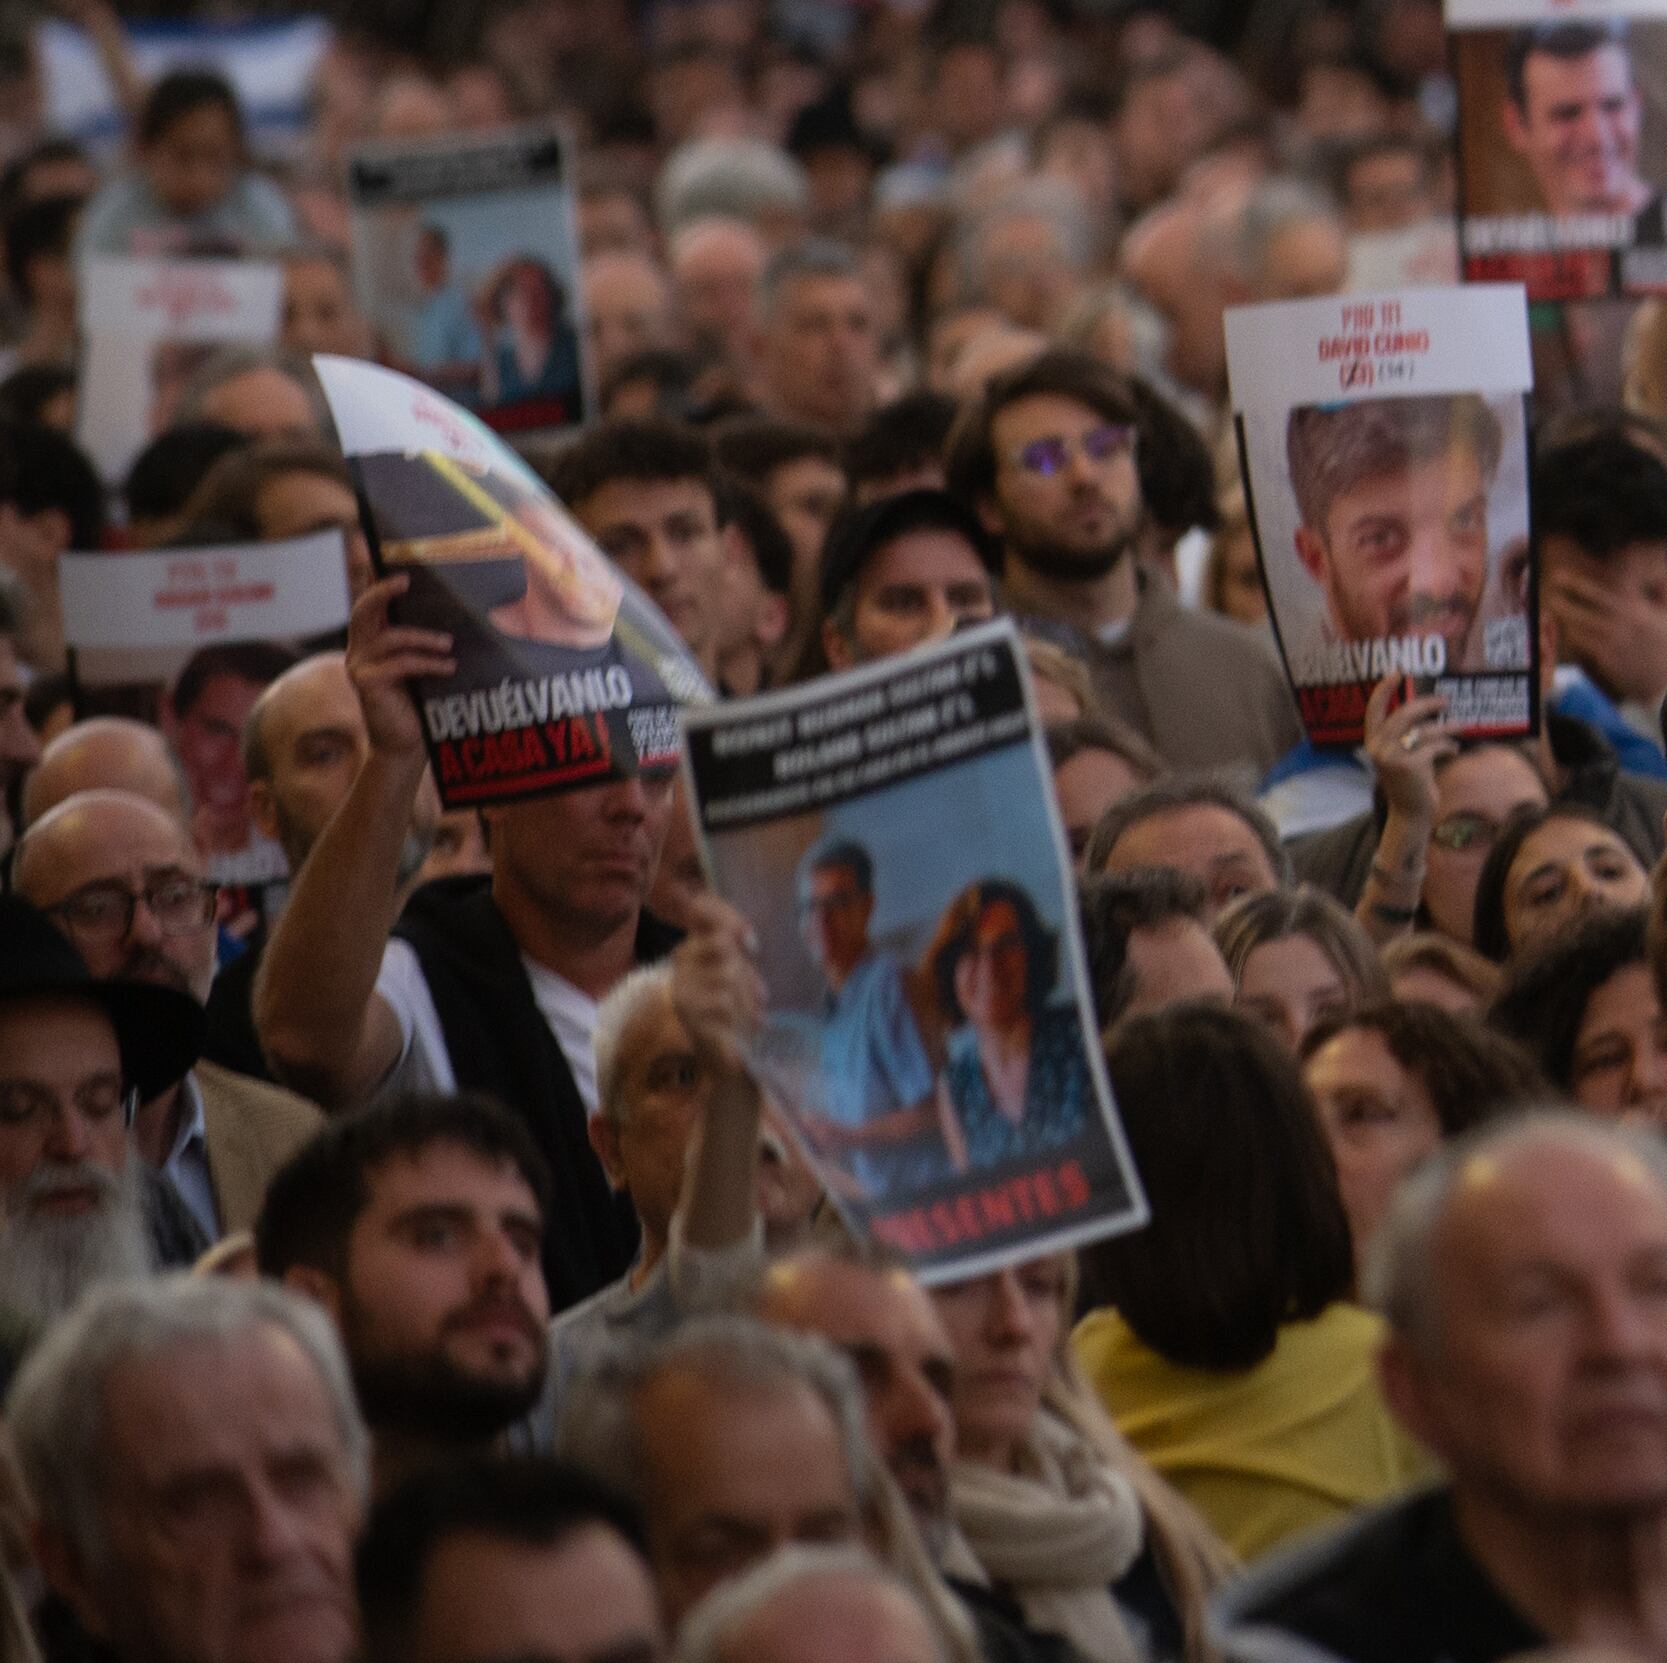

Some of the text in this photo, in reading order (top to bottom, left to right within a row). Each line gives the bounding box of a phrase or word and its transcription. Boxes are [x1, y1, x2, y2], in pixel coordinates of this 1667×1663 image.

[423, 664, 634, 744] DEVUÉLVANLO
[438, 738, 463, 783] A
[462, 725, 548, 776] CASA
